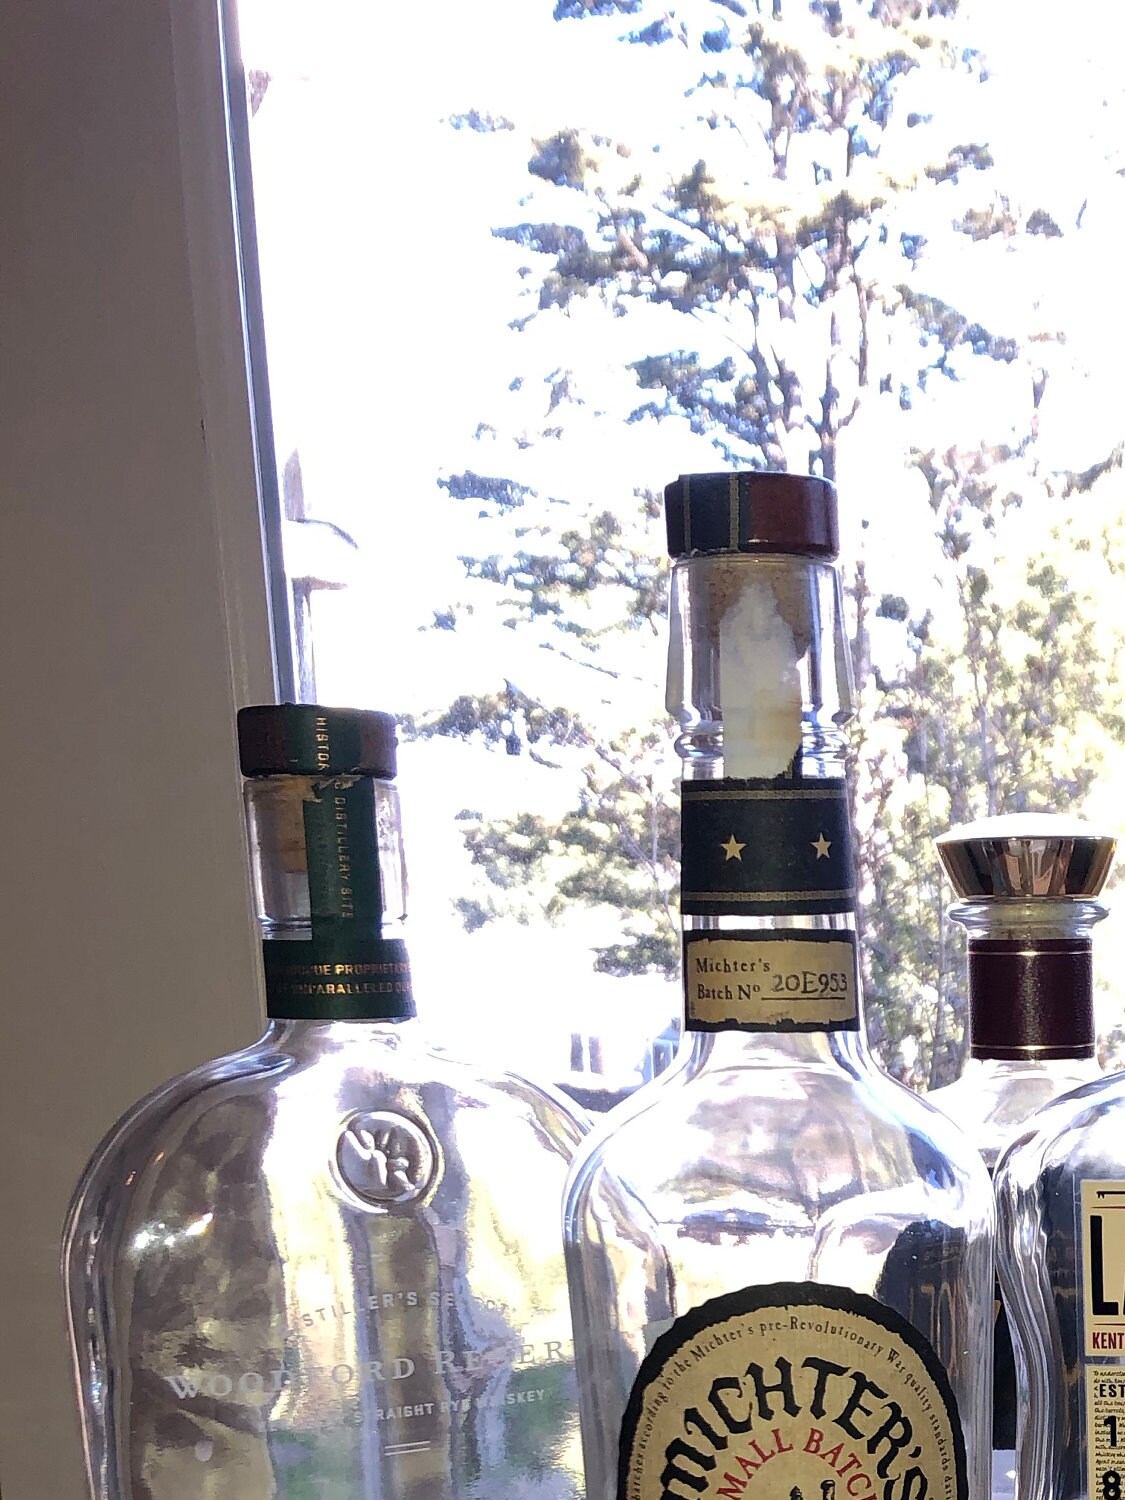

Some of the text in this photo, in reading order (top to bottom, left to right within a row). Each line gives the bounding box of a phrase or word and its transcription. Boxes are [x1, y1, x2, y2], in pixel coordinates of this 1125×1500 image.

[695, 957, 770, 973] Michter's
[697, 984, 732, 1000] Batch
[770, 971, 847, 994] 20E953
[673, 1359, 692, 1378] the
[690, 1323, 754, 1363] Michter's
[760, 1315, 884, 1358] pre-Revolutionary
[886, 1347, 906, 1374] War
[905, 1373, 932, 1413] quality
[929, 1410, 951, 1472] standards
